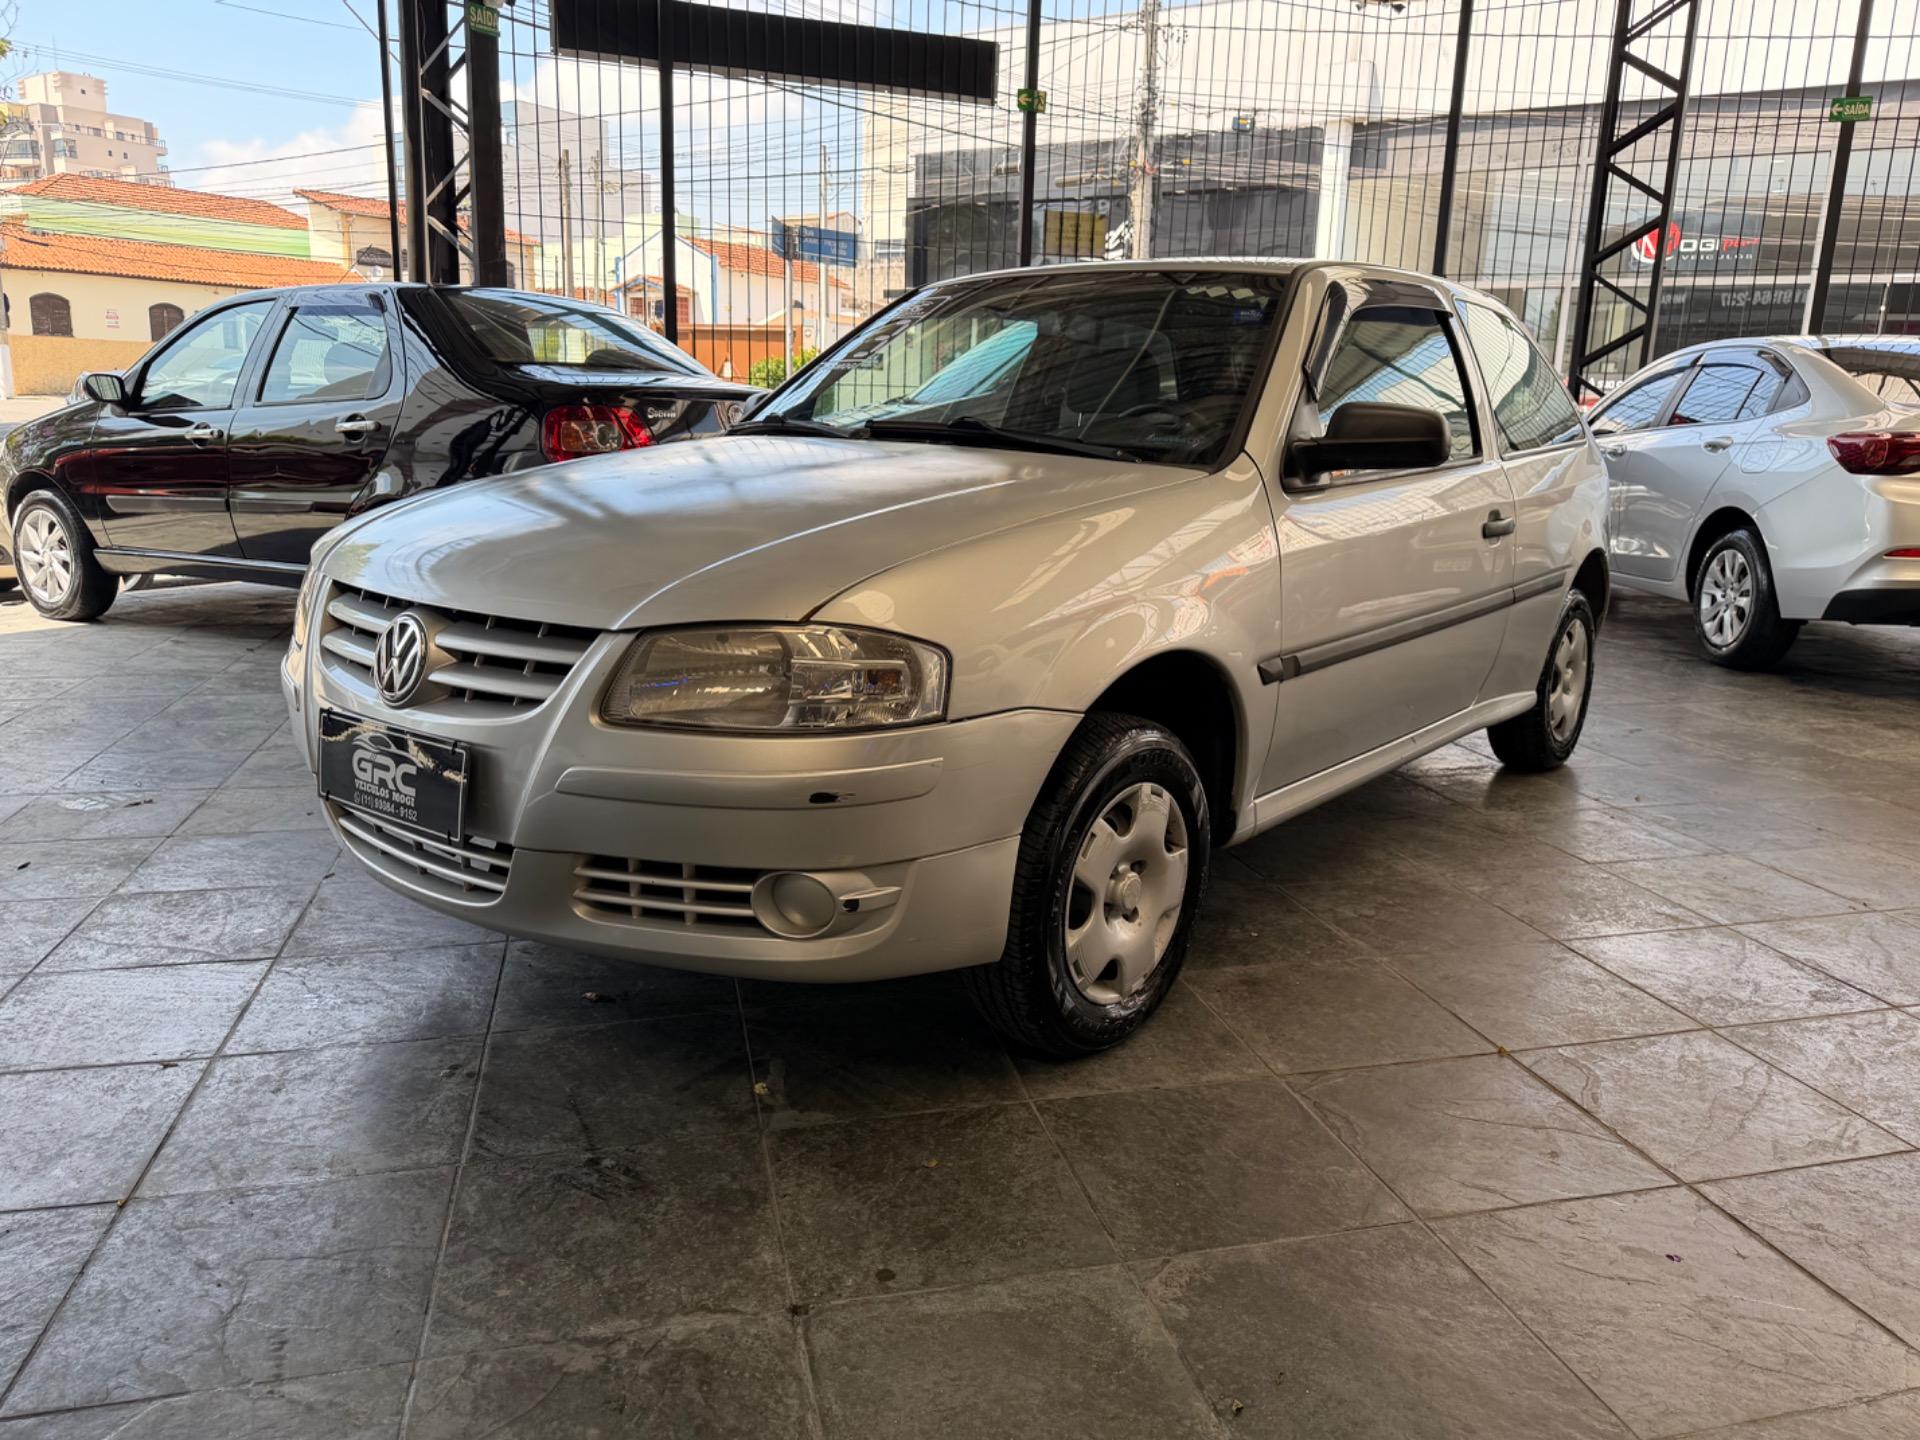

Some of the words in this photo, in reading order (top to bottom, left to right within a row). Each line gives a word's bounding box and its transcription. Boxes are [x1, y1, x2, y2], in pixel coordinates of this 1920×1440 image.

[1844, 101, 1869, 116] SAÍDA
[352, 748, 417, 797] GRC
[354, 778, 390, 799] VEICULOS
[392, 791, 415, 807] MOGI
